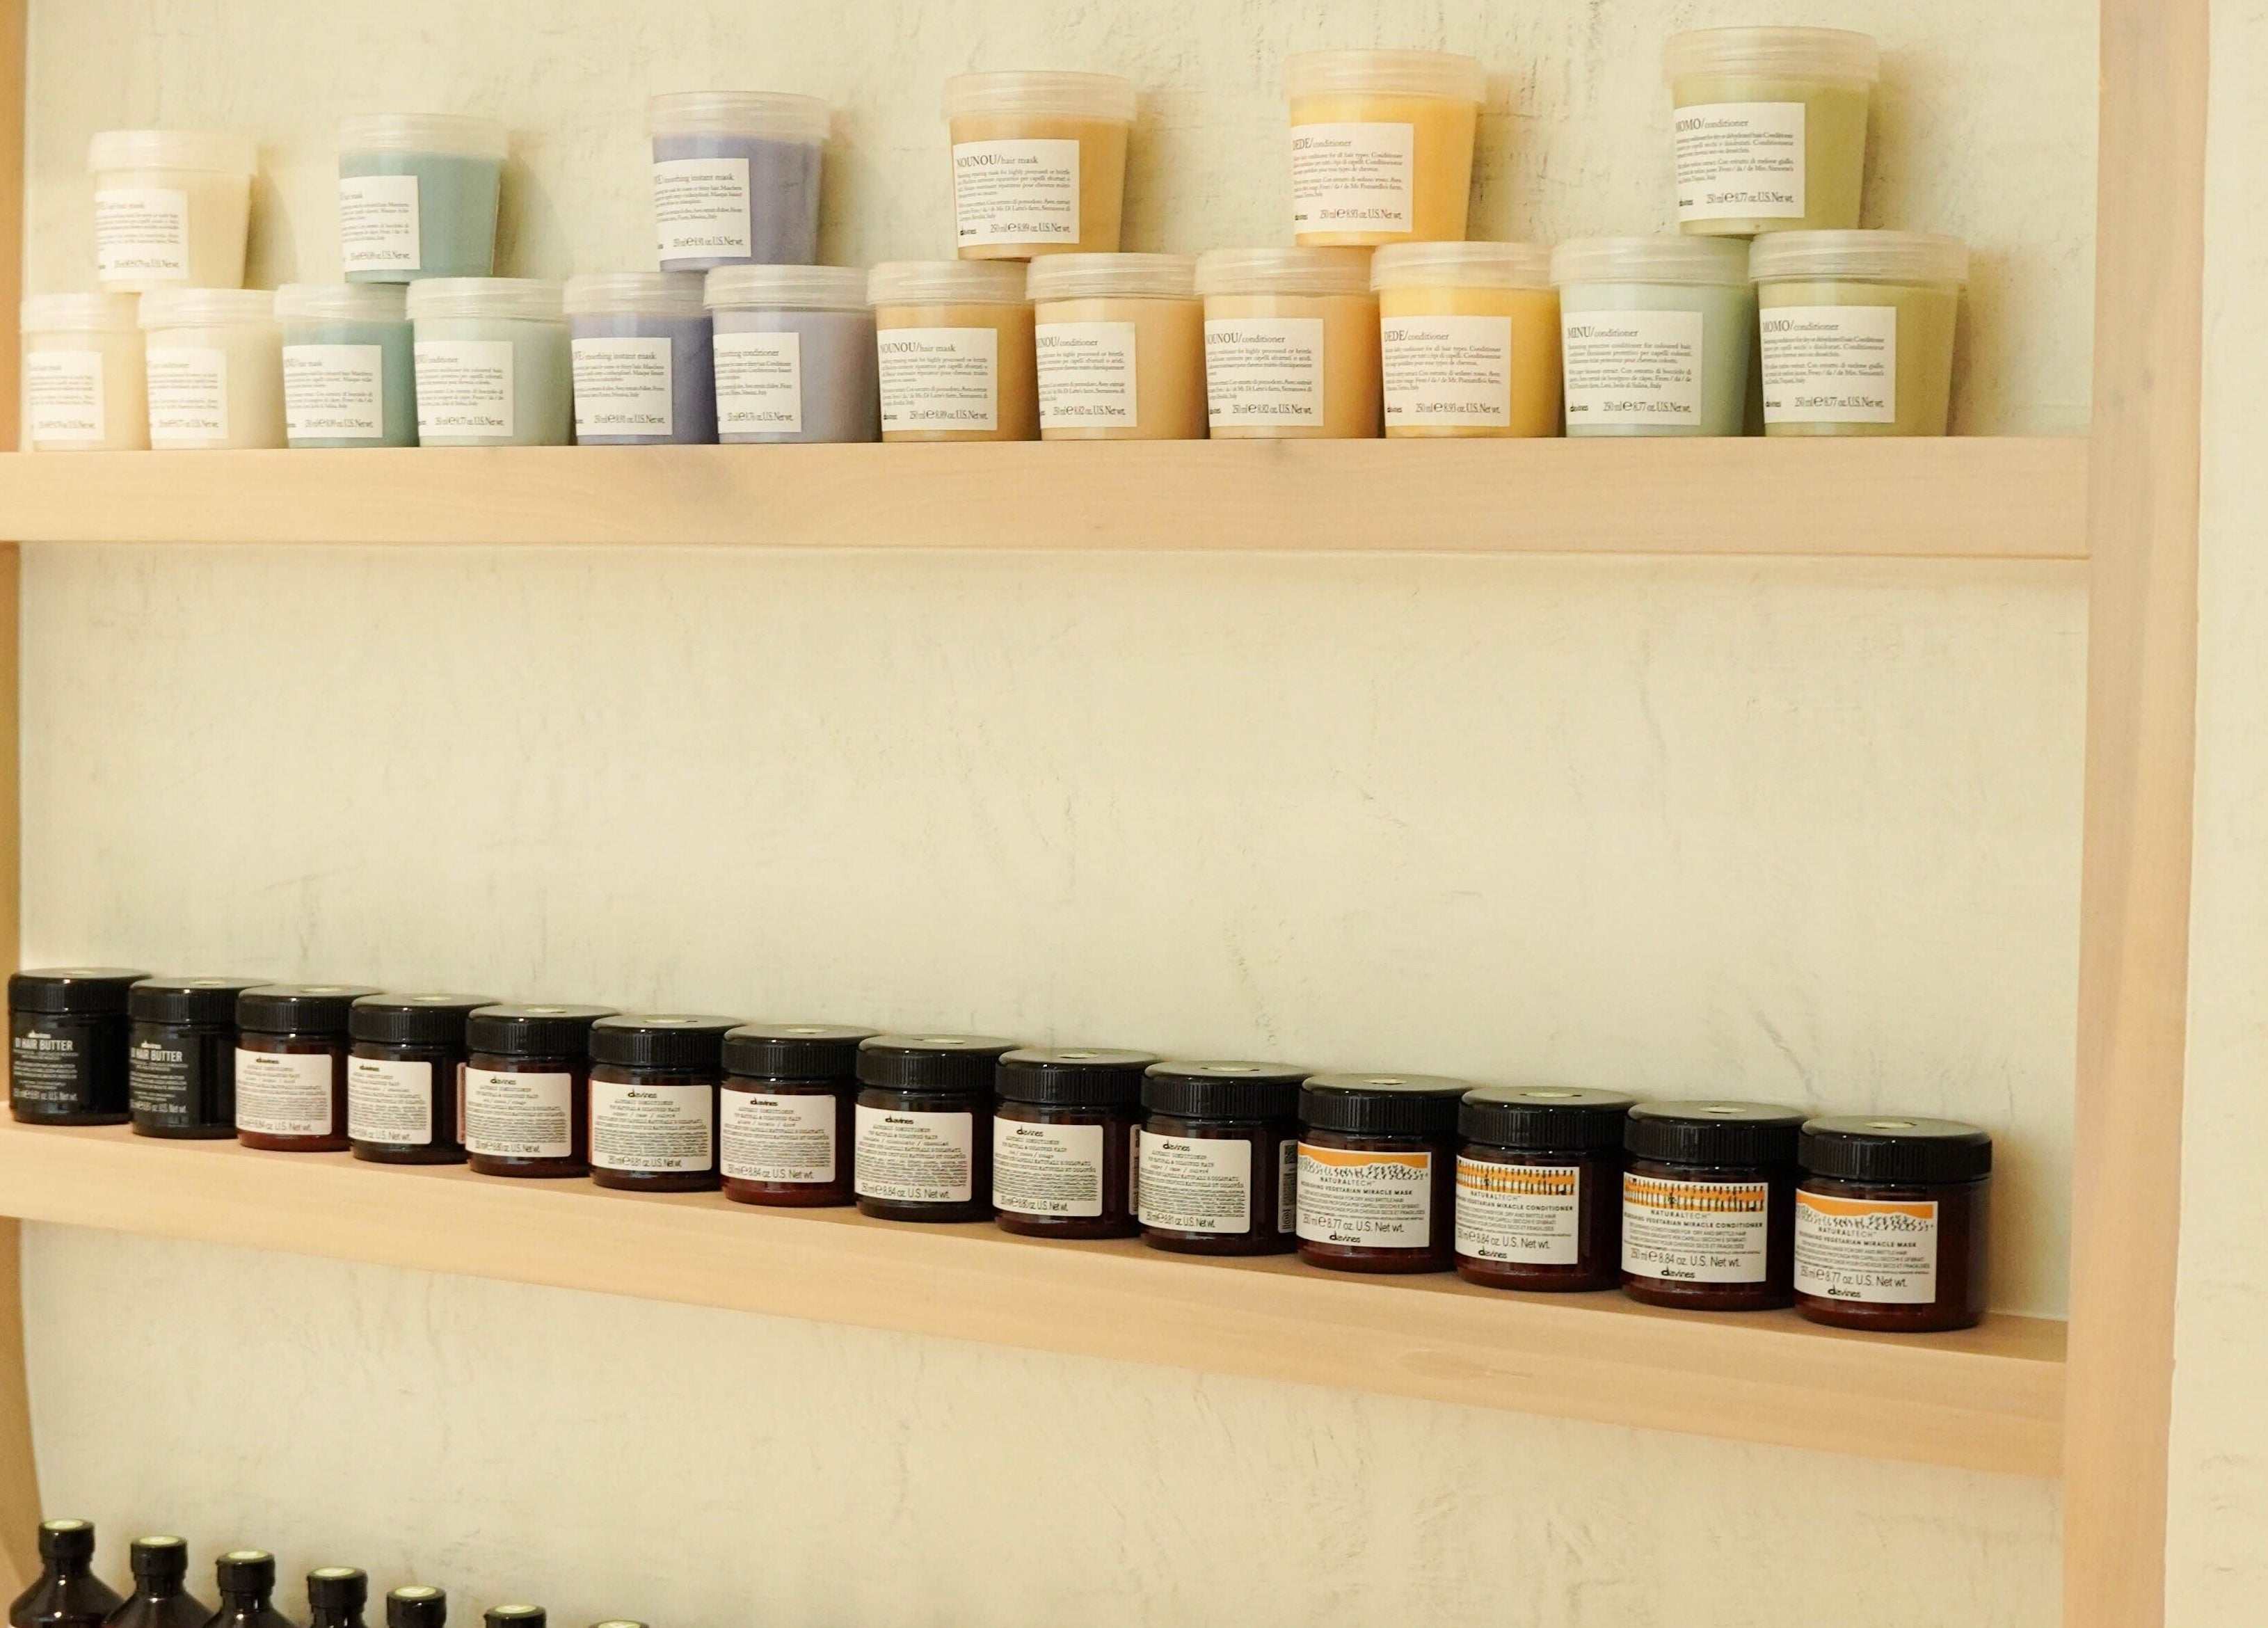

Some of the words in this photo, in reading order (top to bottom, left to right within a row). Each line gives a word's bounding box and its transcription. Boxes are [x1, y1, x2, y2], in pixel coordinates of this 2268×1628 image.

[1018, 155, 1039, 164] mask
[936, 344, 957, 352] mask
[39, 1039, 74, 1051] BUTTER
[150, 1049, 183, 1062] BUTTER
[628, 1090, 657, 1099] davines
[750, 1097, 778, 1106] davines
[885, 1116, 914, 1125] davines
[1016, 1126, 1044, 1138] davines
[1163, 1140, 1191, 1152] davines
[789, 1170, 802, 1179] Net
[924, 1189, 938, 1199] Net
[1325, 1185, 1361, 1194] VEGETARIAN
[1327, 1218, 1342, 1229] 8.77
[1375, 1222, 1390, 1232] Net
[1646, 1217, 1682, 1227] VEGETARIAN
[1329, 1231, 1361, 1243] davines
[1824, 1236, 1861, 1245] VEGETARIAN
[1521, 1238, 1537, 1248] Net
[1478, 1246, 1508, 1259] davines
[1658, 1253, 1675, 1264] 8.84
[1710, 1256, 1727, 1267] Net
[1661, 1266, 1695, 1278] davines
[1826, 1270, 1841, 1282] 8.77
[1876, 1277, 1893, 1287] Net
[1828, 1285, 1861, 1298] davines
